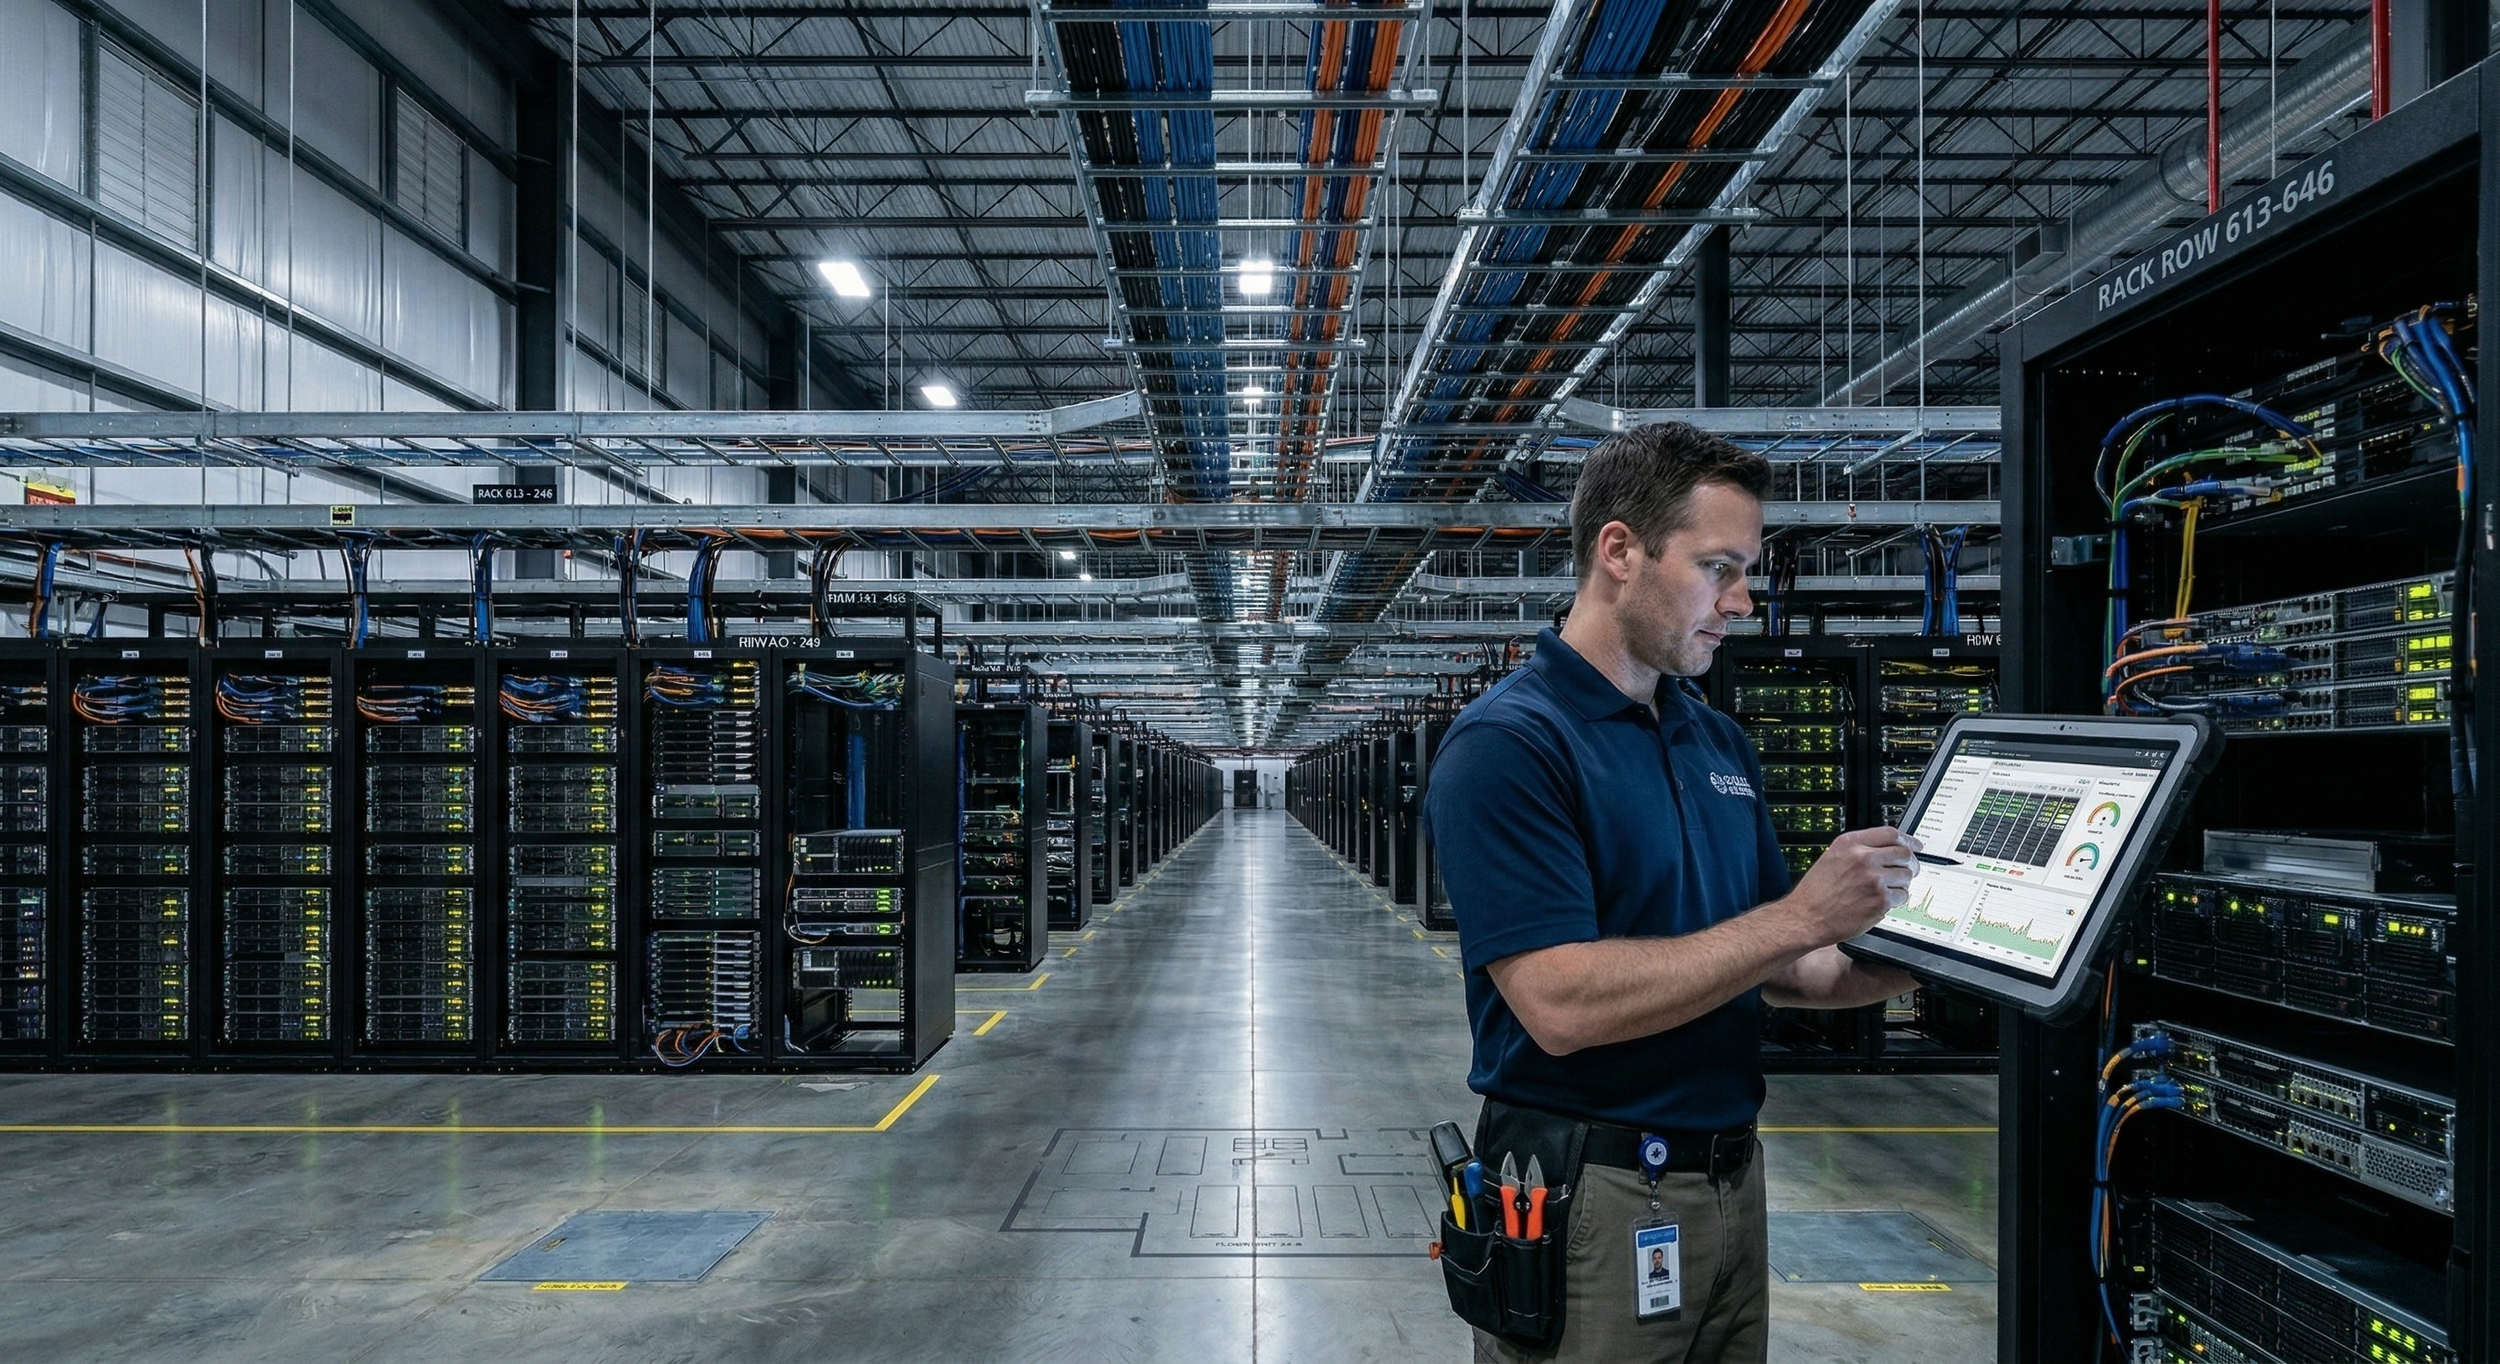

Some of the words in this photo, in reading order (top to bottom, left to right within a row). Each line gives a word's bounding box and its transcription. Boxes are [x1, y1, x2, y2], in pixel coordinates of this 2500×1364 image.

[2098, 256, 2155, 312] RACK
[2161, 222, 2220, 280] ROW
[2225, 159, 2335, 243] 613-646
[478, 488, 503, 499] RACK
[505, 488, 524, 499] 613
[533, 488, 553, 499] 246
[799, 637, 821, 648] 249
